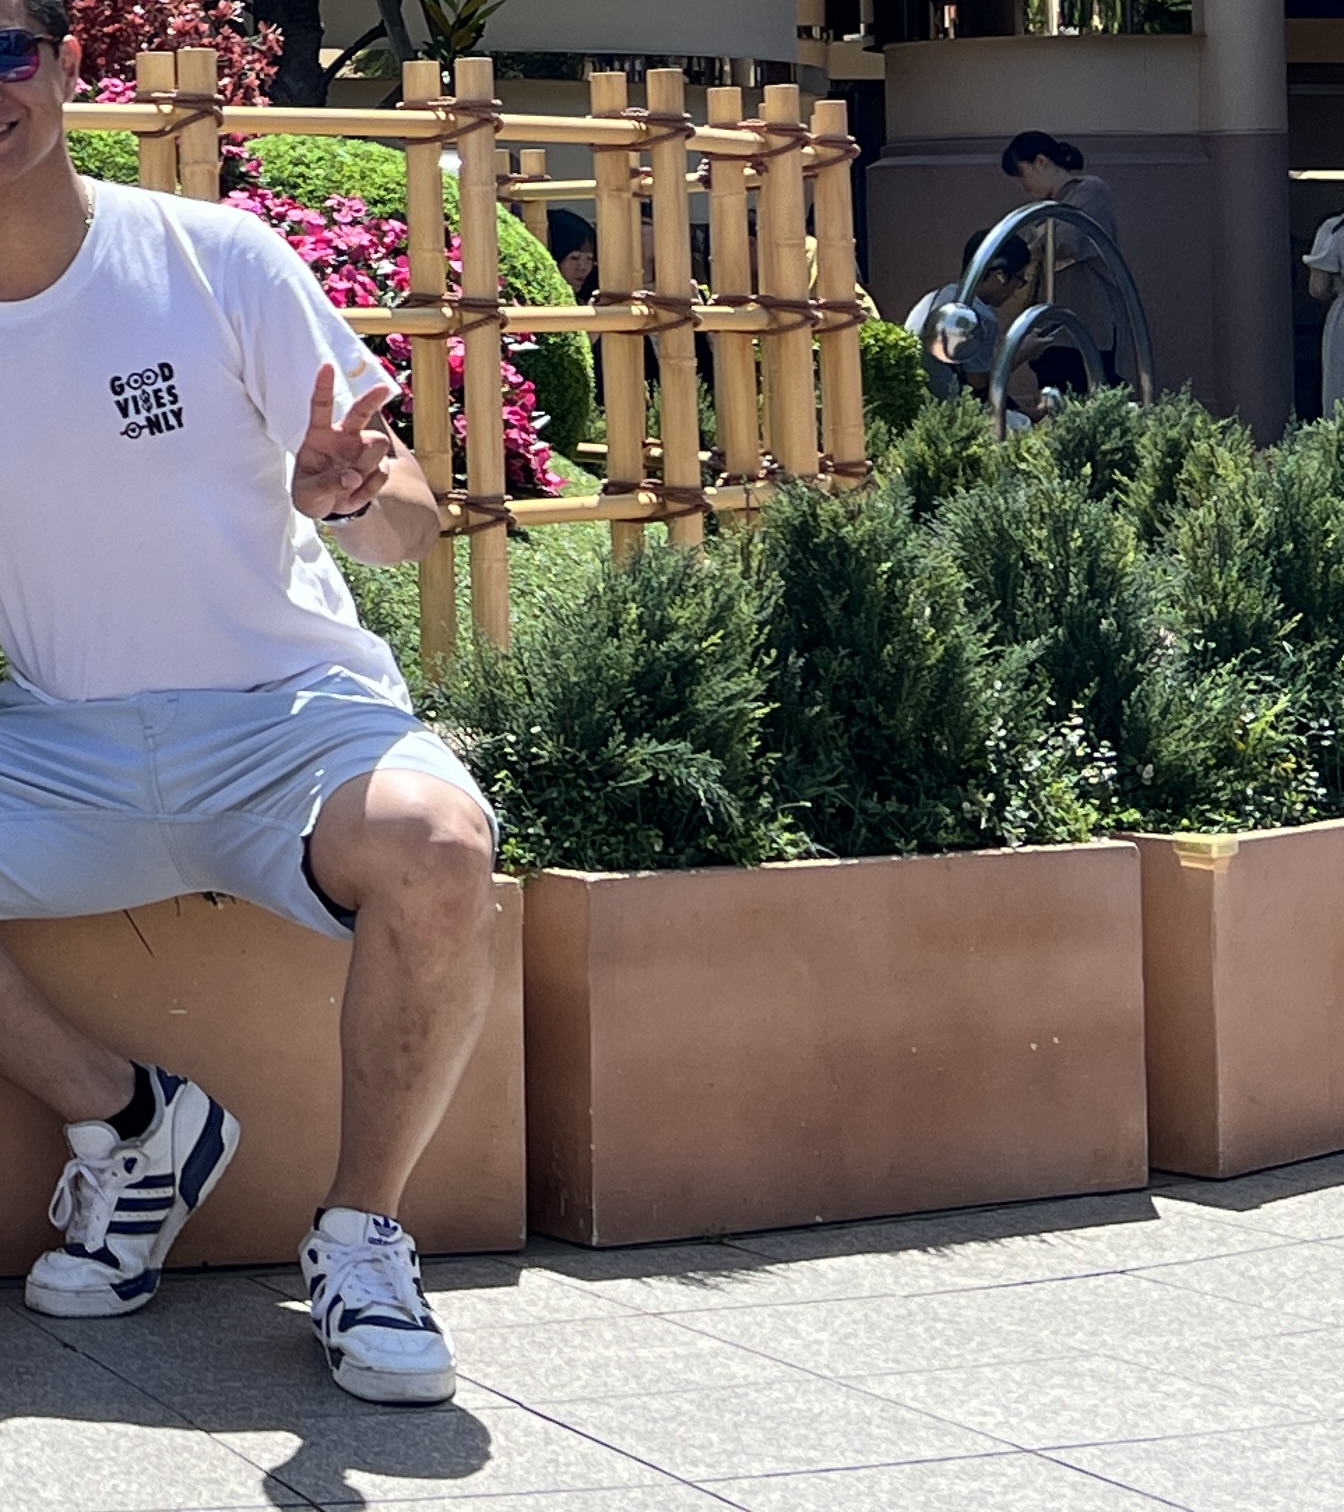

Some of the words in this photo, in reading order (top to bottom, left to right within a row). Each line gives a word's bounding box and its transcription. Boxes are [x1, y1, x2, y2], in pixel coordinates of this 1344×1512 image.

[110, 362, 174, 396] GOOD
[114, 384, 179, 419] VIBES
[120, 406, 184, 439] ONLY
